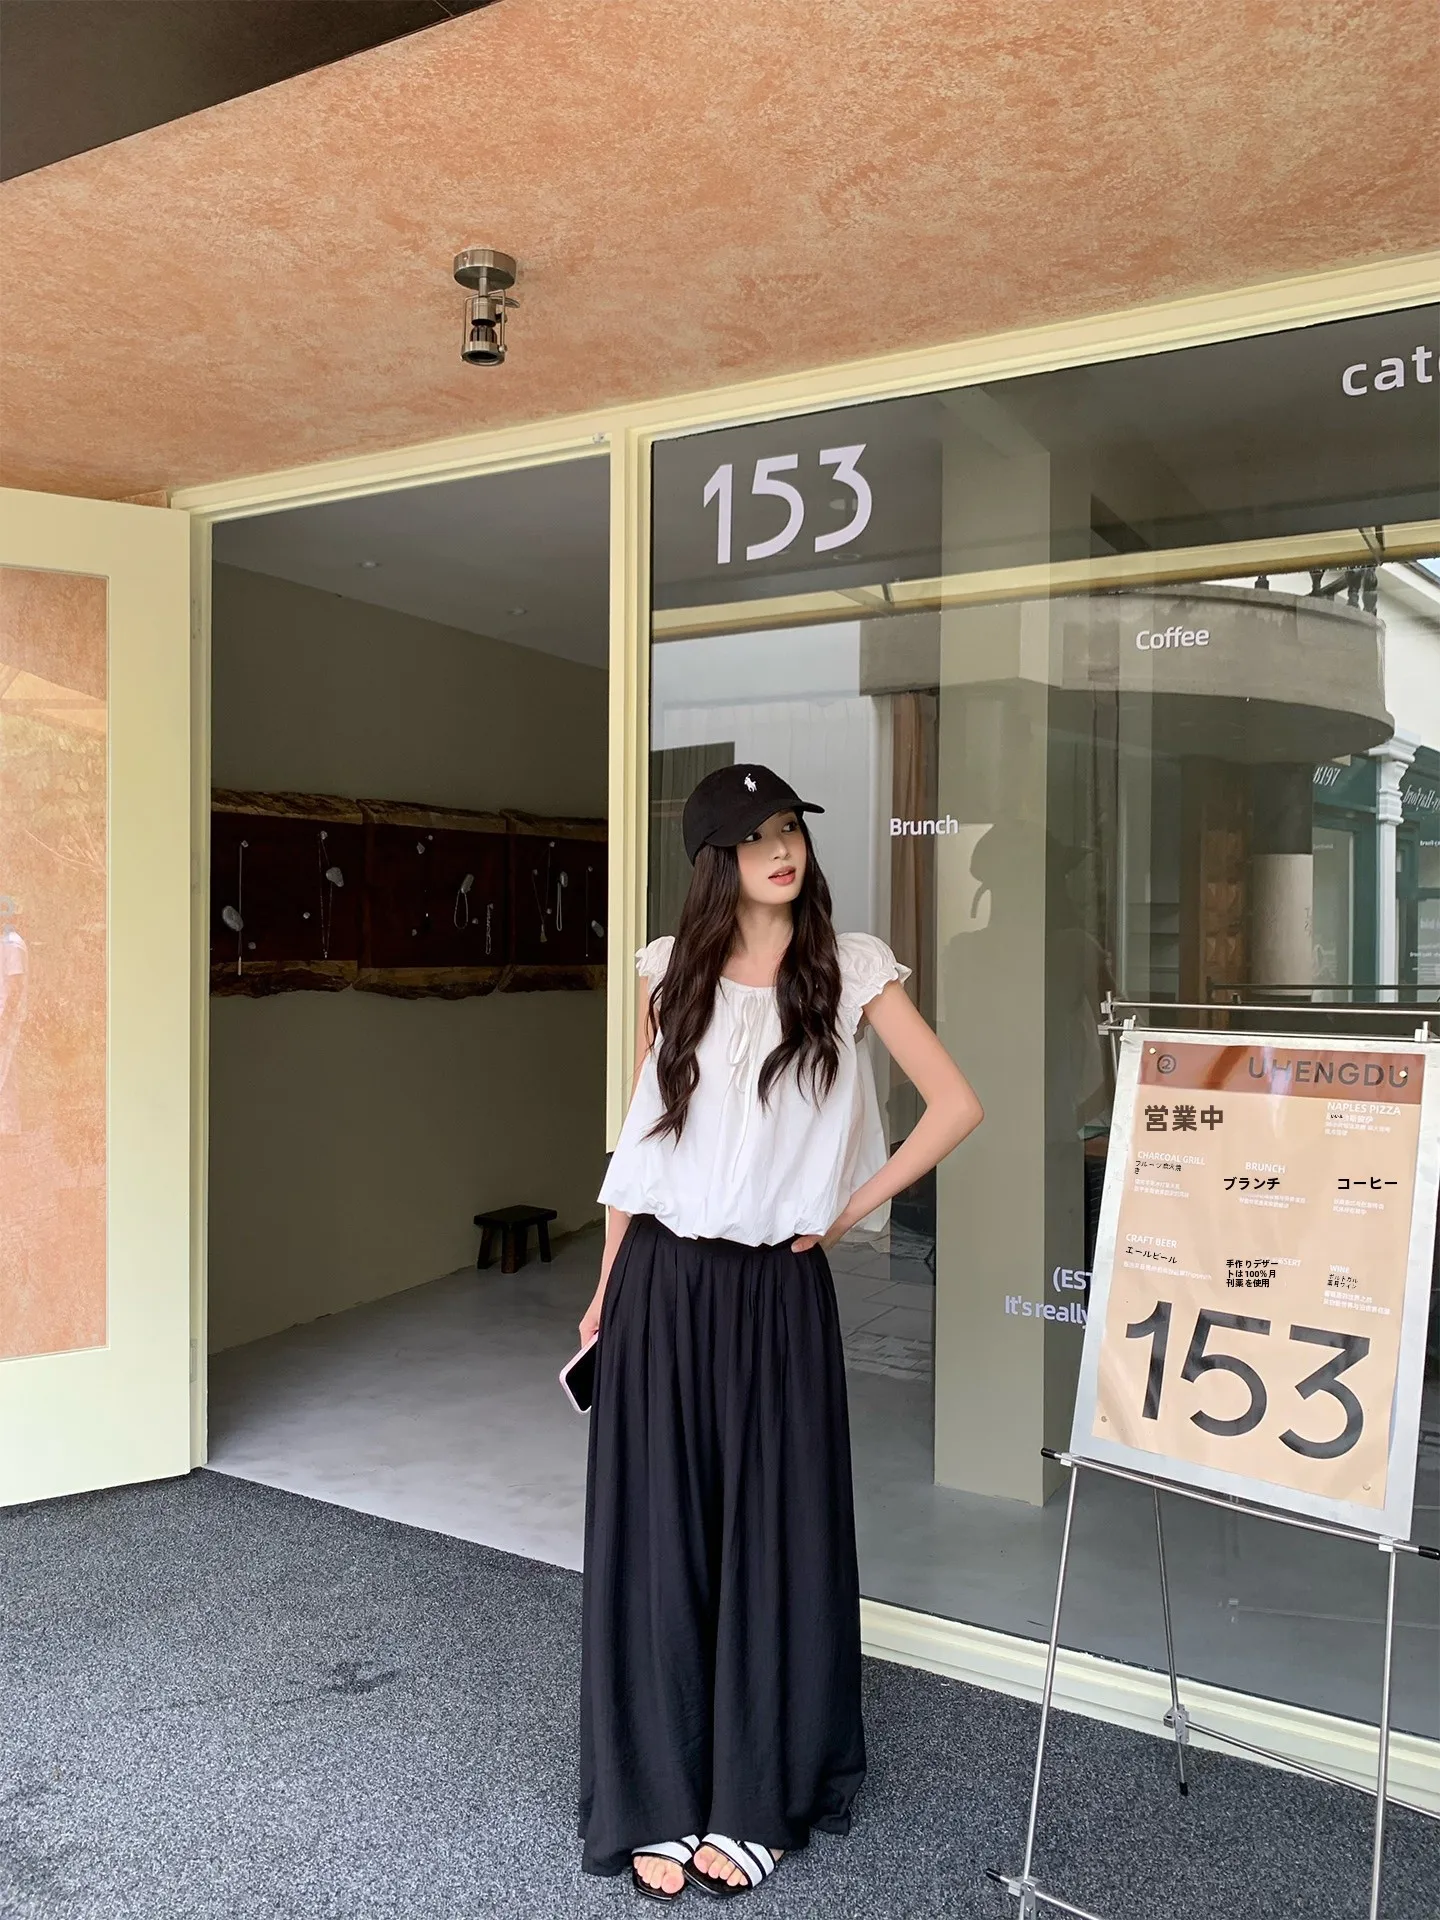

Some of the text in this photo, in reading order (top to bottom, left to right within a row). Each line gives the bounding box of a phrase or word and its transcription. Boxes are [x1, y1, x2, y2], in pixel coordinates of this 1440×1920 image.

[1342, 345, 1440, 396] cat
[703, 443, 872, 564] 153
[1136, 625, 1210, 650] Coffee
[890, 814, 959, 836] Brunch
[1144, 1104, 1223, 1132] 営業中
[1327, 1102, 1401, 1116] NAPLES PIZZA
[1137, 1150, 1206, 1166] CHARCOAL GRILL
[1245, 1161, 1286, 1174] BRUNCH
[1223, 1176, 1280, 1191] ブランチ
[1338, 1176, 1398, 1190] コーヒー
[1125, 1233, 1178, 1249] CRAFT BEER
[1005, 1295, 1032, 1317] It's
[1125, 1300, 1371, 1459] 153
